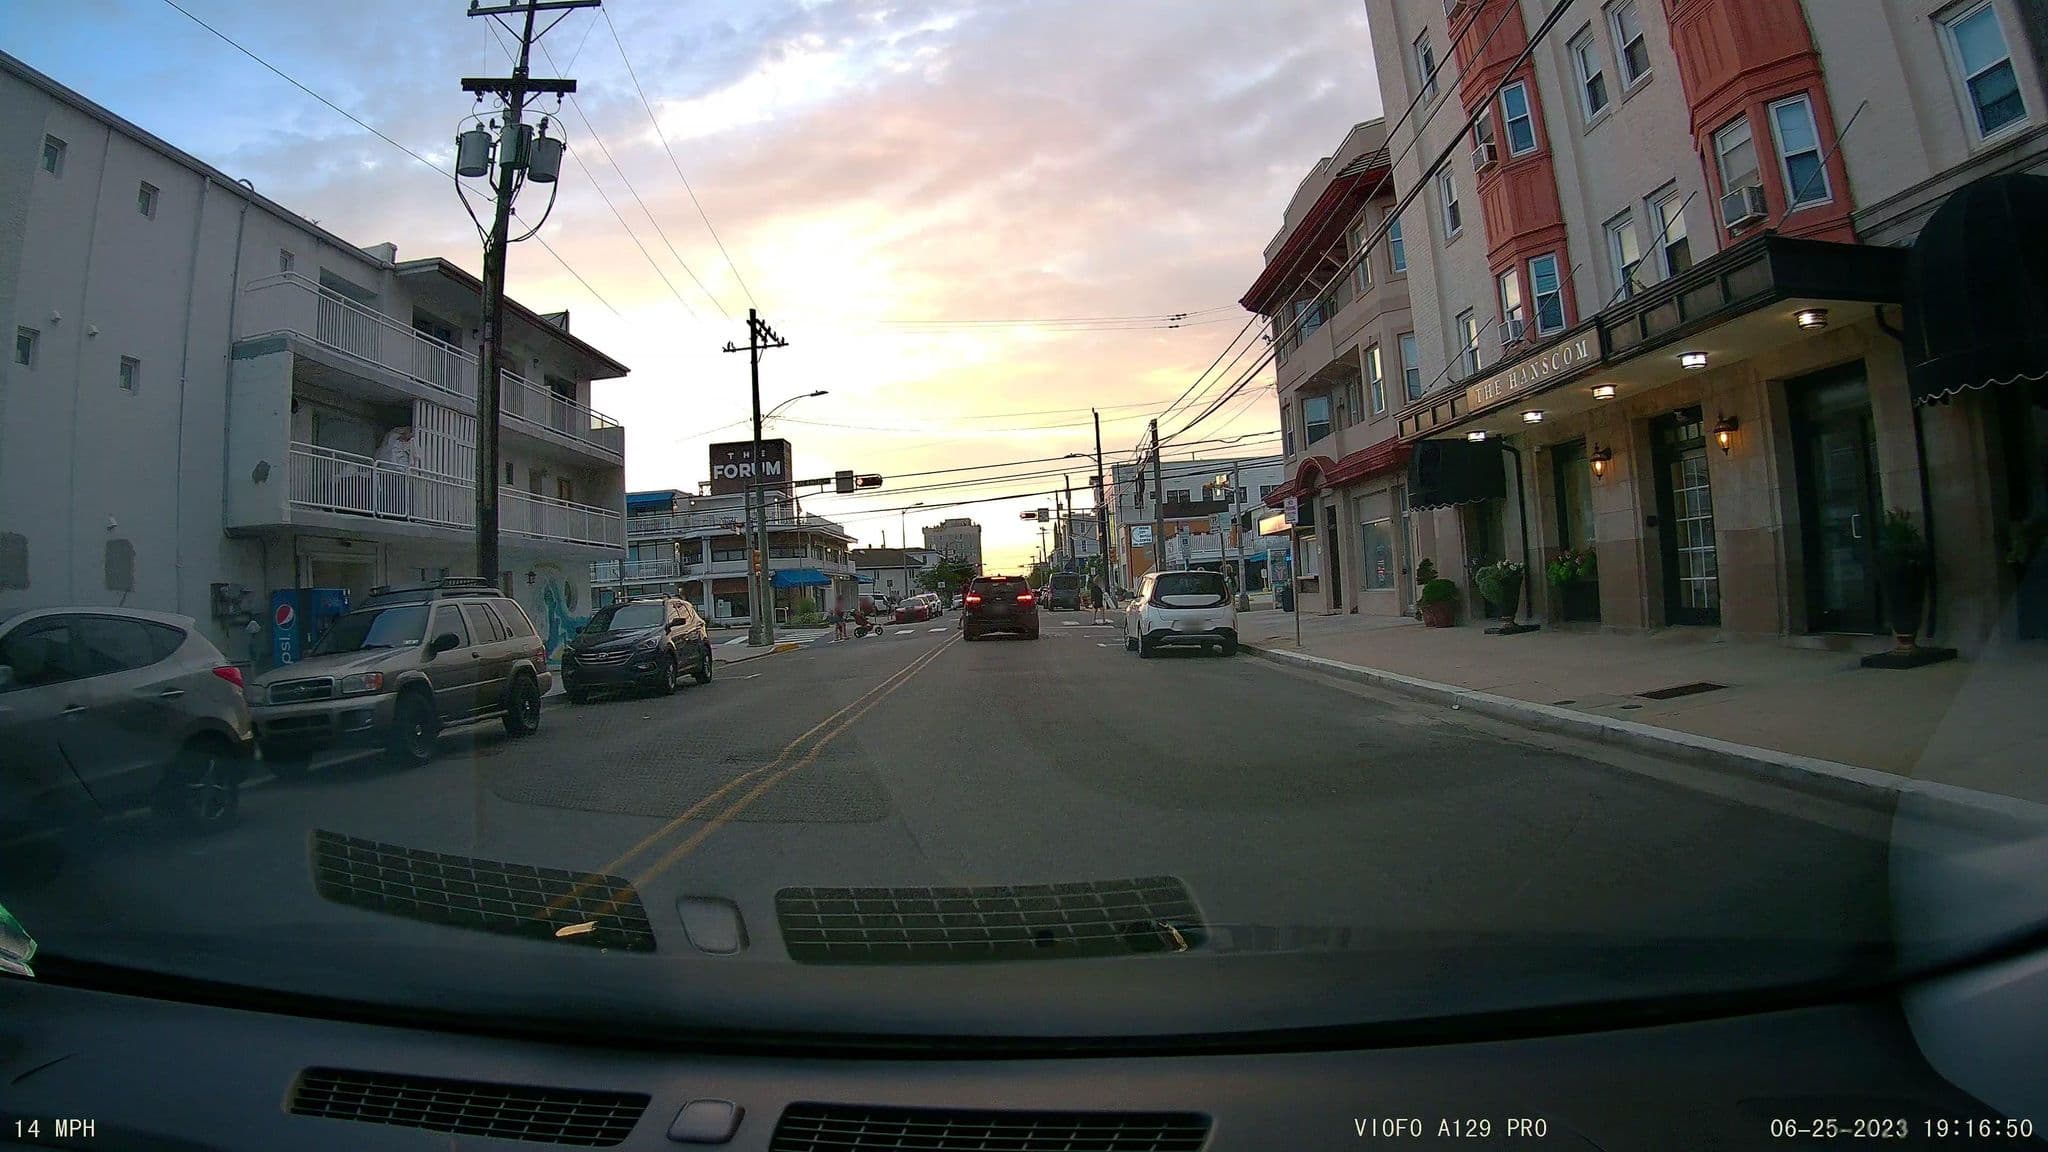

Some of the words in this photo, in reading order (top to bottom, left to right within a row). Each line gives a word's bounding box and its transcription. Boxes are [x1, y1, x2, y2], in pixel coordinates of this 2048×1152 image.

[1475, 380, 1502, 403] THE
[1508, 340, 1588, 390] HANSCOM
[727, 449, 766, 460] THE
[713, 460, 781, 480] FORUM
